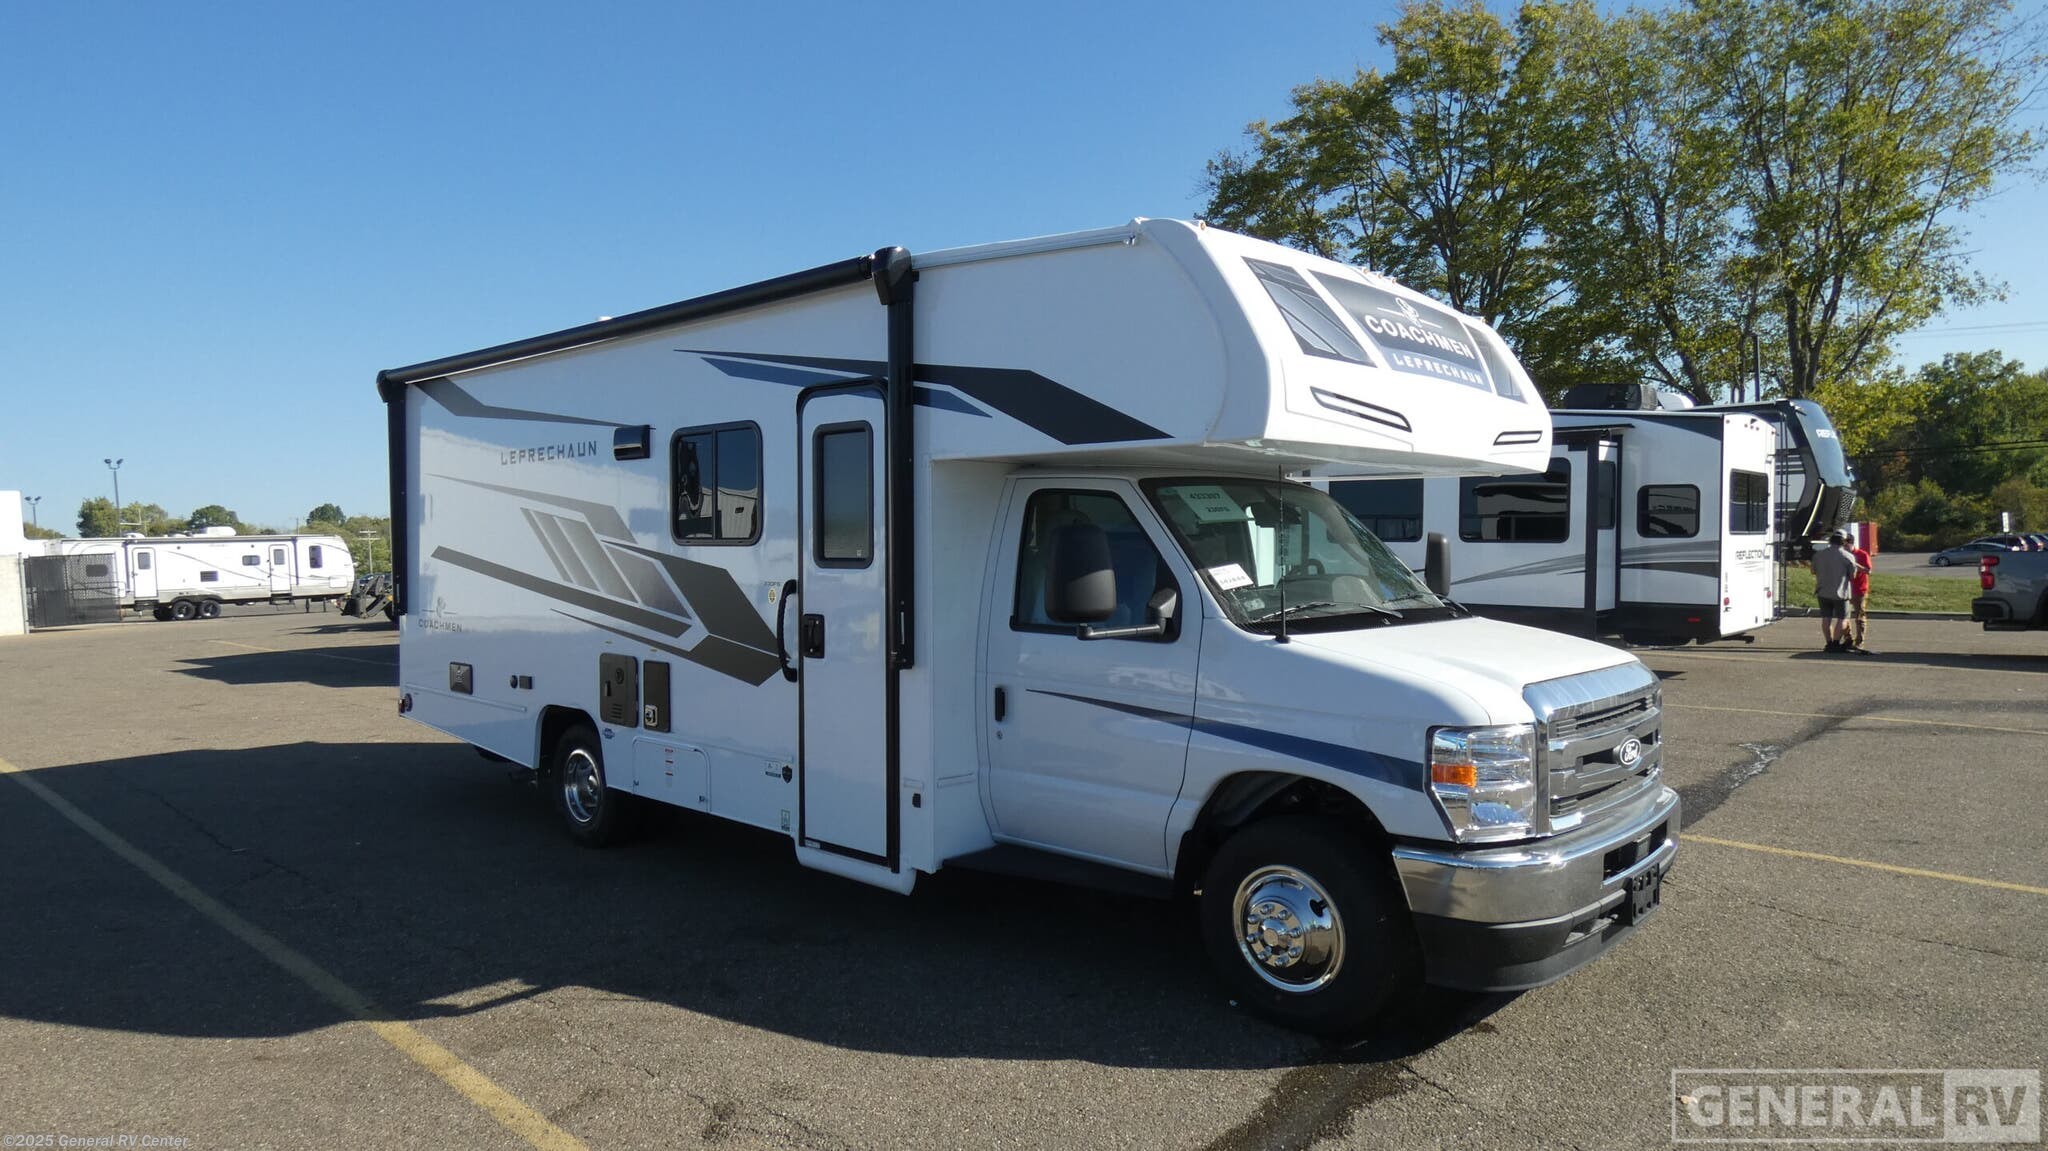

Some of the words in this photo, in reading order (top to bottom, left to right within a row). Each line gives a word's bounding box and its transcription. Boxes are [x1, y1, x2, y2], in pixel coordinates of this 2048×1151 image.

[1364, 314, 1475, 360] COACHMEN
[1391, 352, 1484, 386] LEPRECHAUN
[500, 440, 598, 466] LEPRECHAUN
[417, 618, 463, 633] COACHMEN
